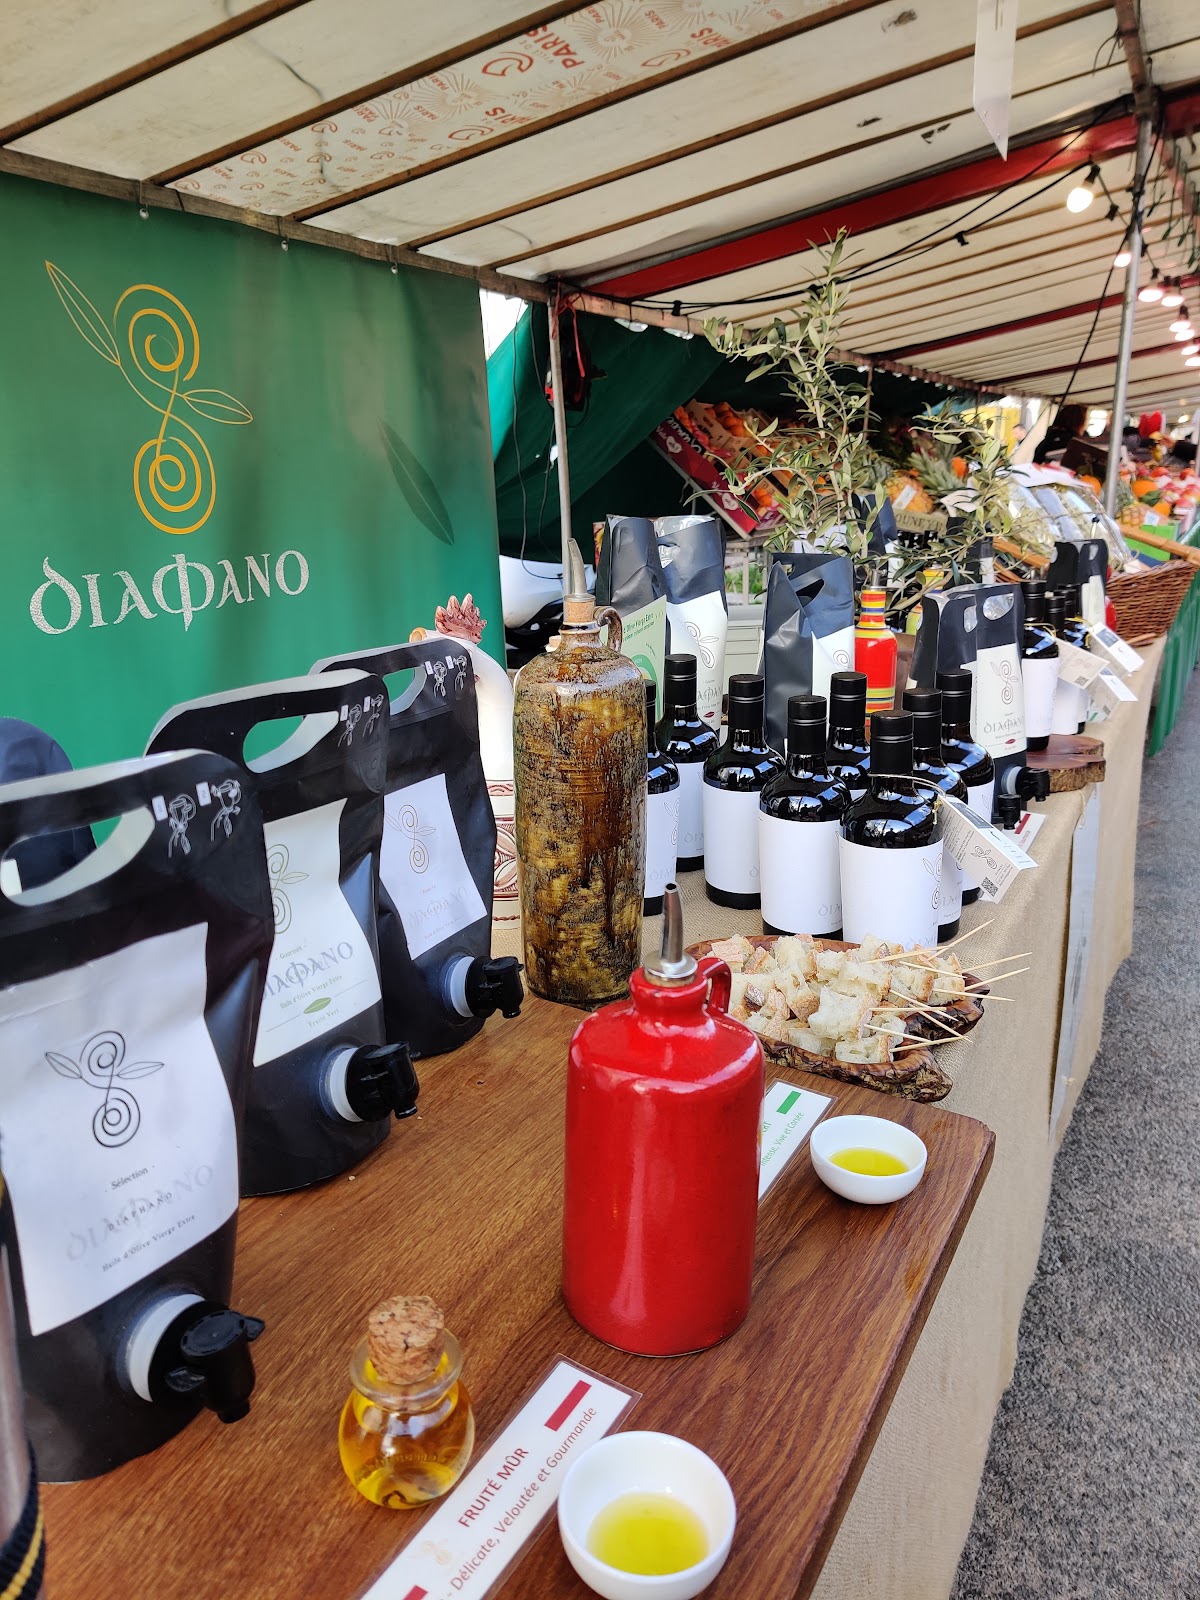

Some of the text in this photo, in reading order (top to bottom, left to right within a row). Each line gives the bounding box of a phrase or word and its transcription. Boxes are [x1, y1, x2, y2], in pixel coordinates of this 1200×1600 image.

[279, 945, 303, 959] Gourmet
[312, 982, 329, 992] Vierge
[326, 1008, 339, 1018] Vert
[761, 1145, 780, 1167] ntense,
[774, 1132, 788, 1147] Vive
[790, 1112, 804, 1130] Corsée
[111, 1167, 149, 1190] Sélection
[108, 1192, 173, 1232] DIAPHANO
[102, 1214, 196, 1273] Huile d'Olive Vierge Extra
[450, 1407, 597, 1591] Délicate, Veloutée et Gourmande
[457, 1447, 529, 1528] FRUITÉ MÛR
